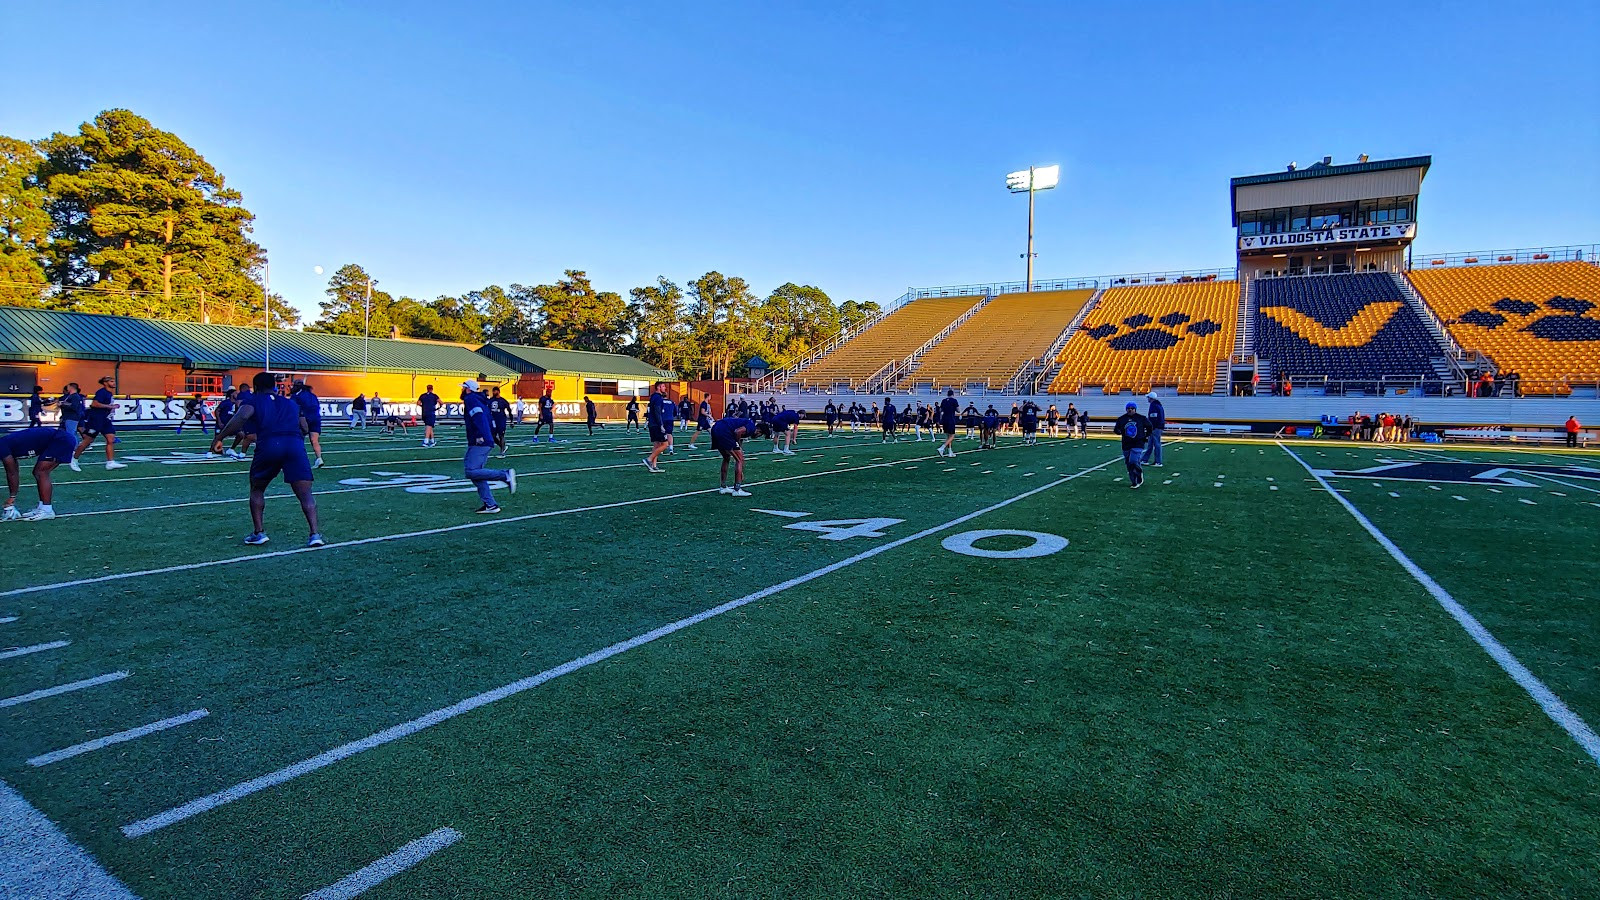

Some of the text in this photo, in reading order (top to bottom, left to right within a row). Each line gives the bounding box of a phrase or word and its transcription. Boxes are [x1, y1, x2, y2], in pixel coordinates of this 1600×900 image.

[1260, 230, 1334, 246] VALDOSTA
[1338, 226, 1391, 240] STATE
[0, 399, 187, 421] BERS
